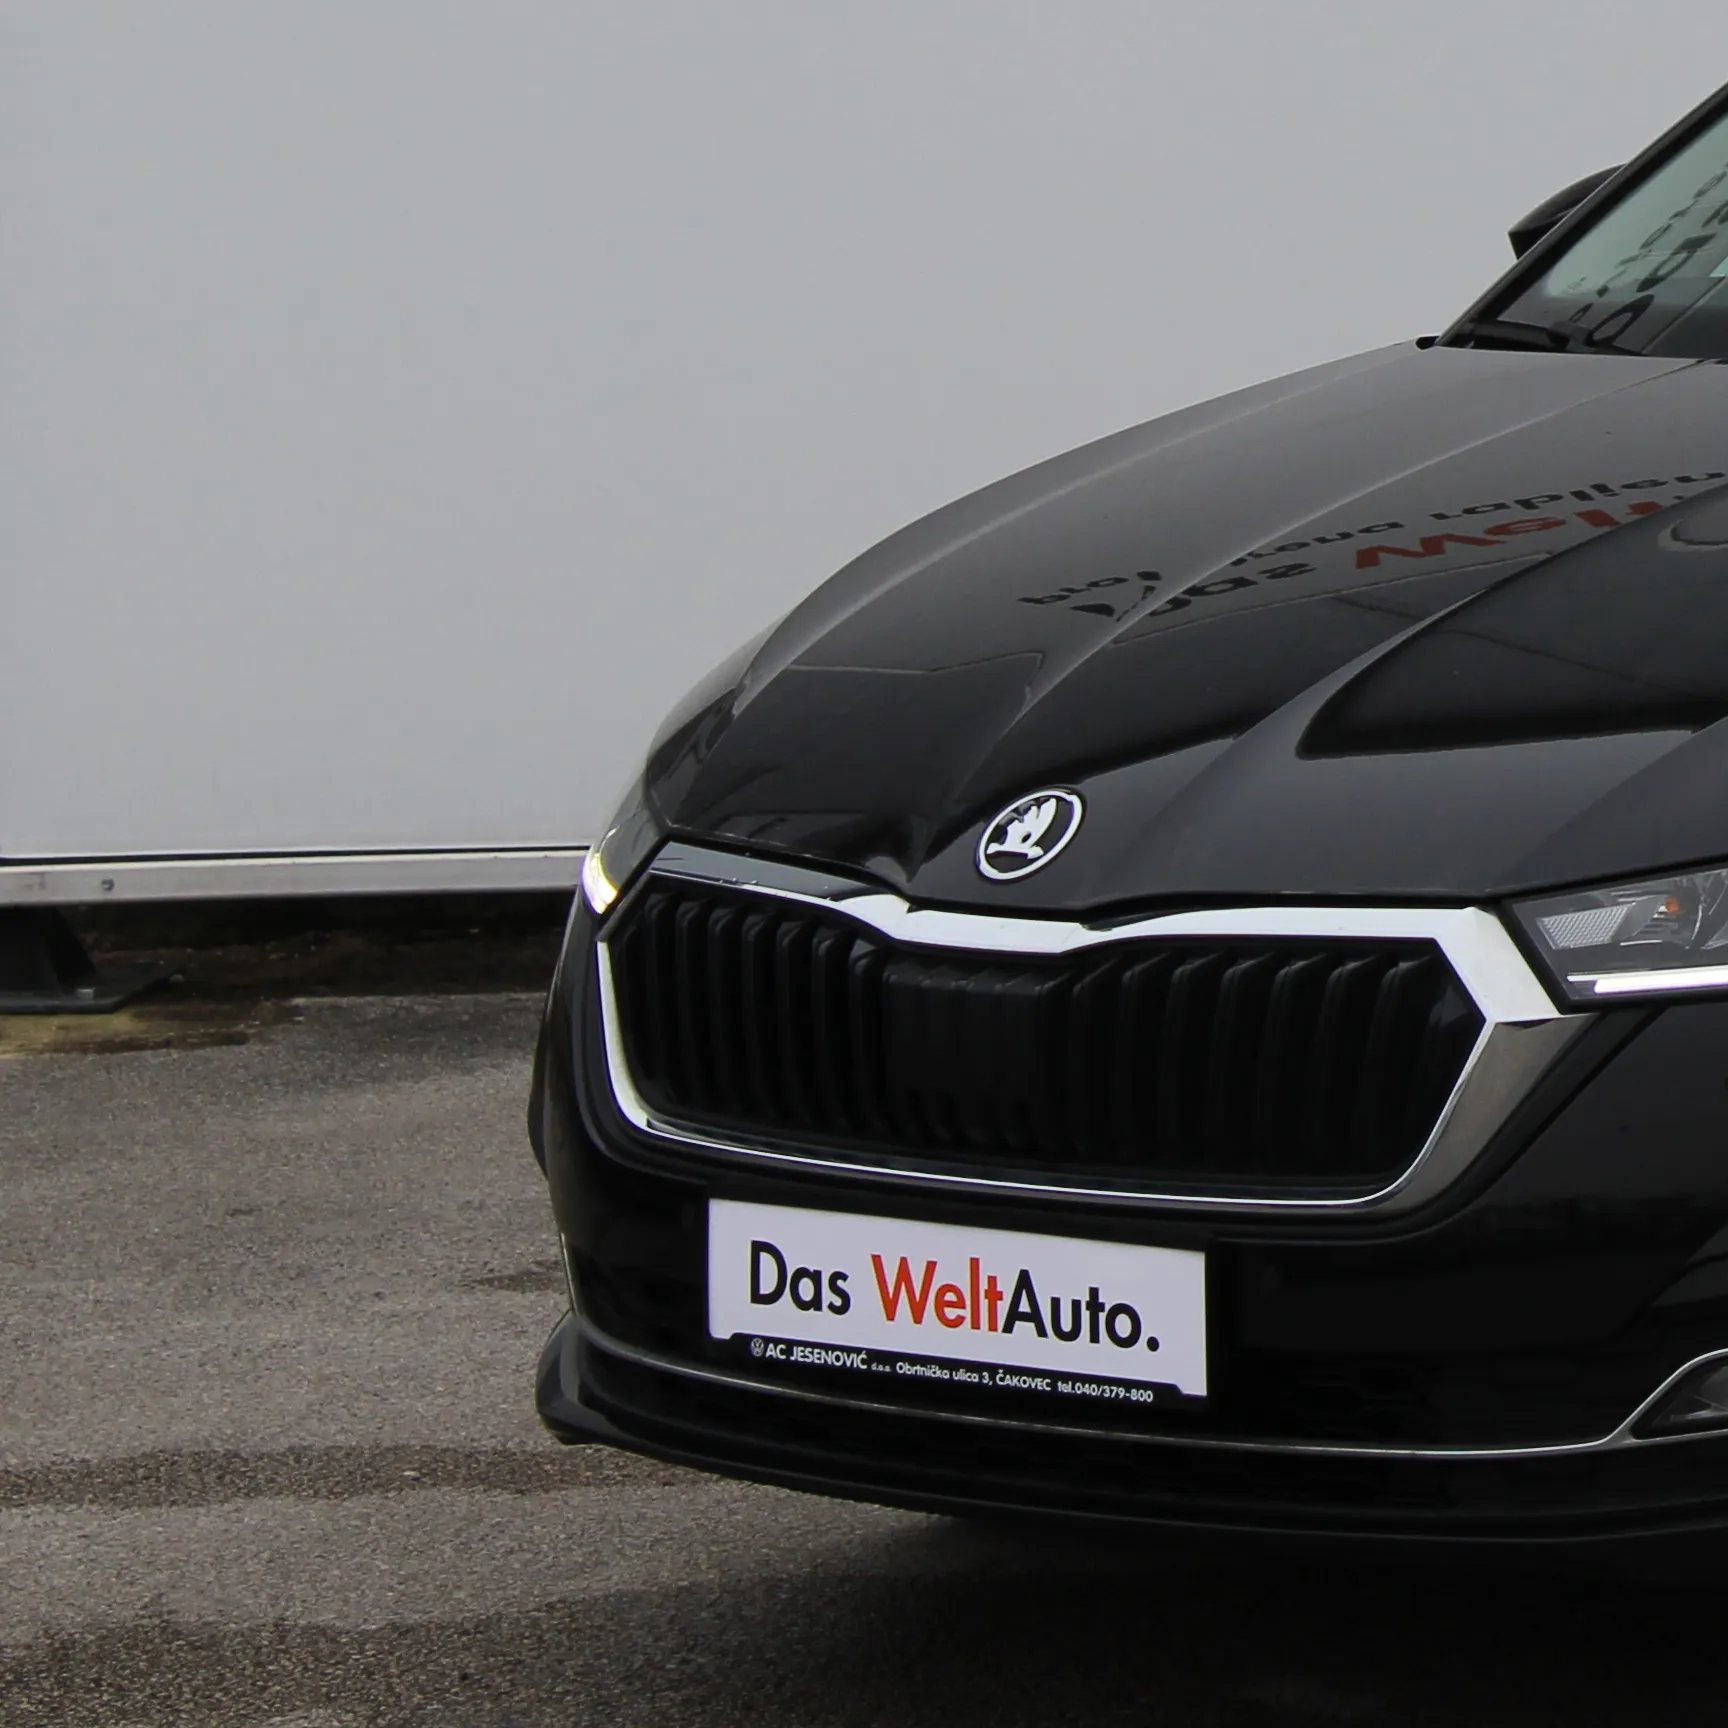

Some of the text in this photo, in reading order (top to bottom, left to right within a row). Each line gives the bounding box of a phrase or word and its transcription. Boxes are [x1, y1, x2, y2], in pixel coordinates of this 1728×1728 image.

[750, 1239, 1161, 1353] Das WeltAuto.
[765, 1343, 787, 1359] AC
[790, 1346, 868, 1370] JESENOVIĆ
[896, 1361, 951, 1379] Obrtnička
[952, 1368, 979, 1382] ulica
[981, 1372, 993, 1386] 3,
[996, 1370, 1051, 1391] ČAKOVEC
